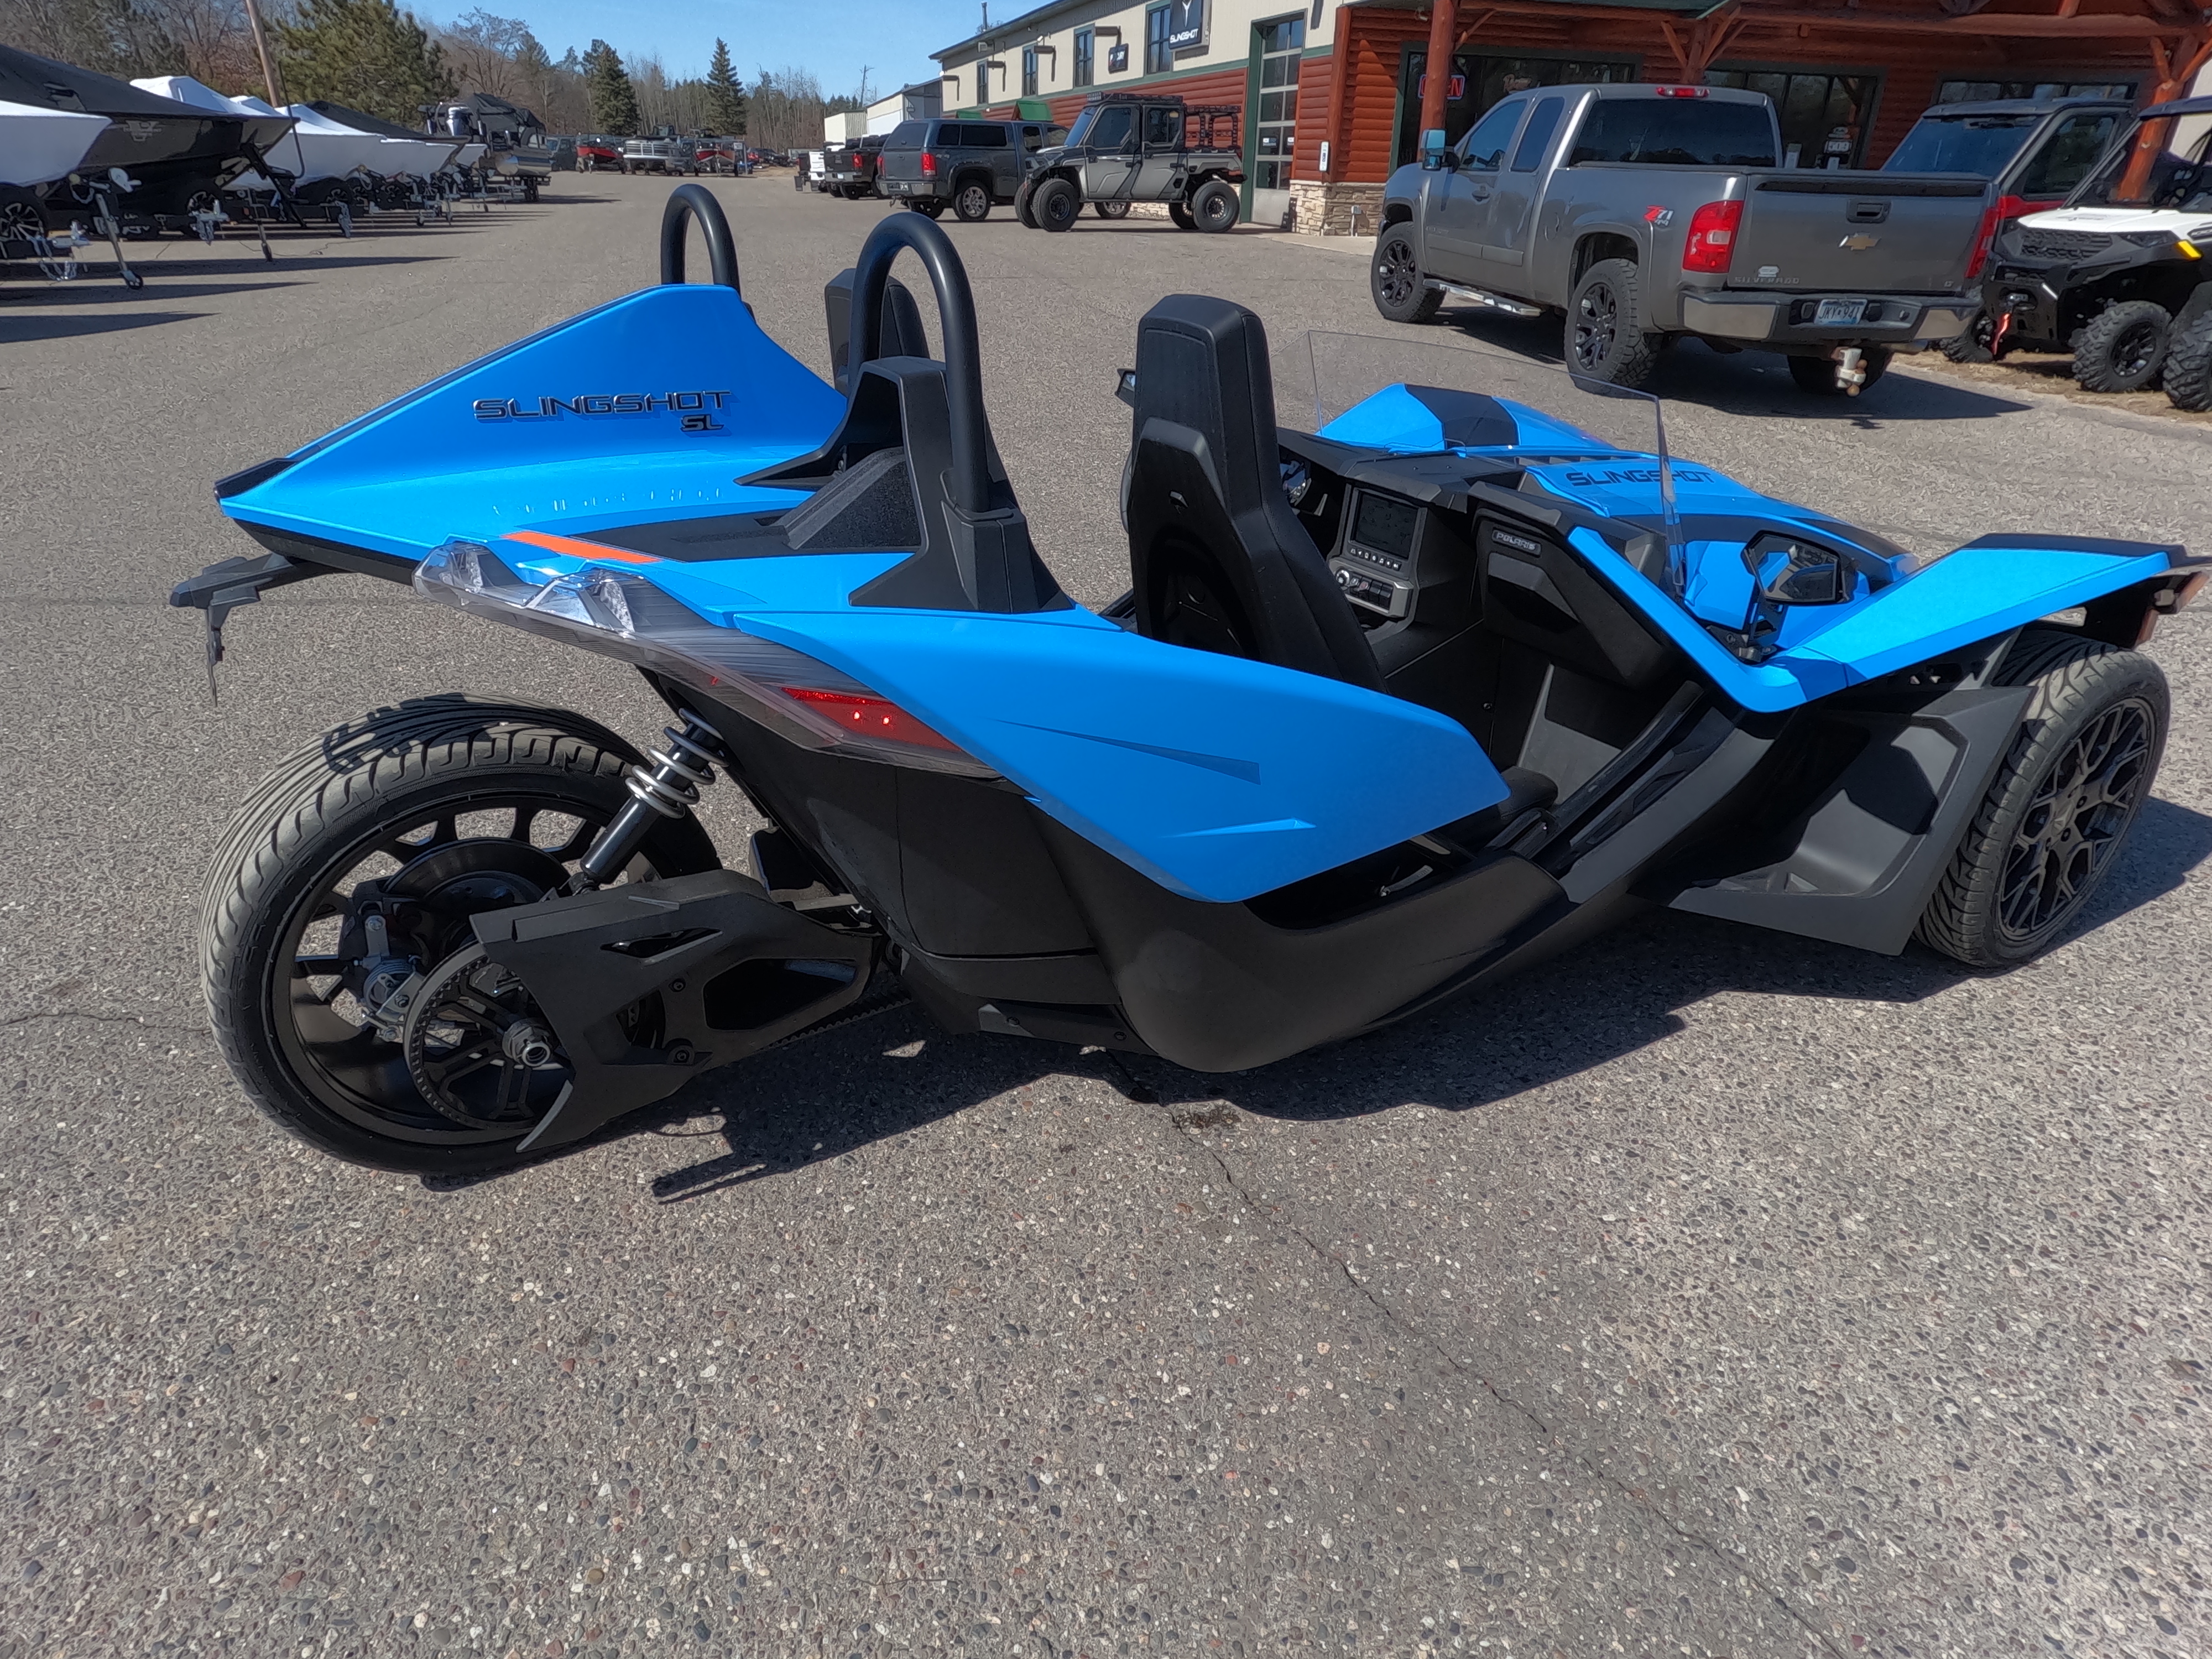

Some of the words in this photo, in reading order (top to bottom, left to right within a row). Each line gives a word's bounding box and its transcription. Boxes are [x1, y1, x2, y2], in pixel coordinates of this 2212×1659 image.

[1170, 28, 1199, 44] SLINGSHOT
[1643, 205, 1674, 221] Z71
[473, 390, 732, 420] SLINGSHOT
[681, 414, 725, 432] SL
[1566, 469, 1715, 487] SLINGSHOT
[1496, 531, 1536, 550] POLARIS
